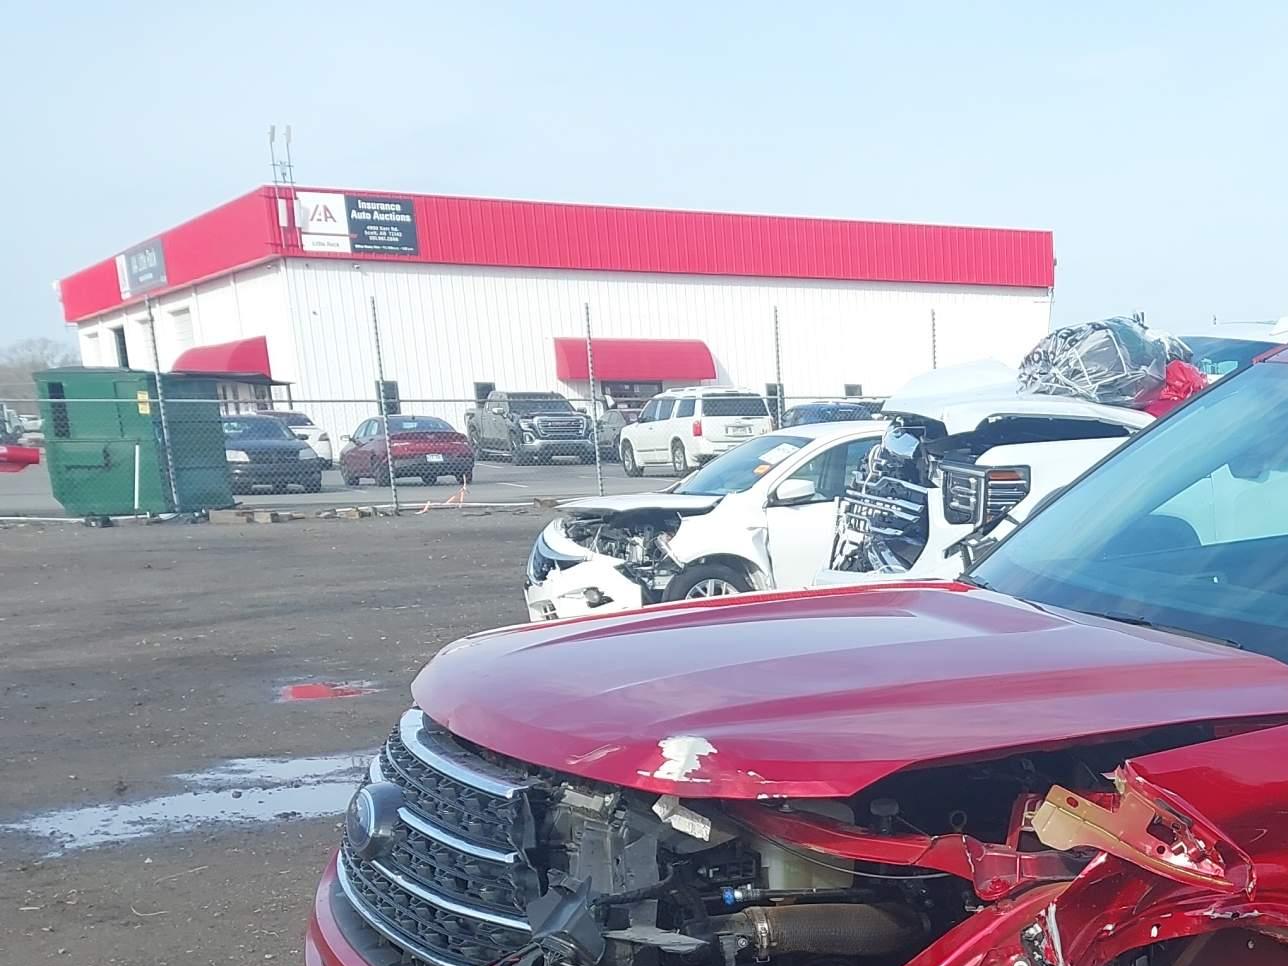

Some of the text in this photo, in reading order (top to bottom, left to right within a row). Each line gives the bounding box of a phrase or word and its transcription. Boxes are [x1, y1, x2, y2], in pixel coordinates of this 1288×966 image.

[358, 199, 401, 211] Insurance
[350, 209, 411, 222] Auto Auctions
